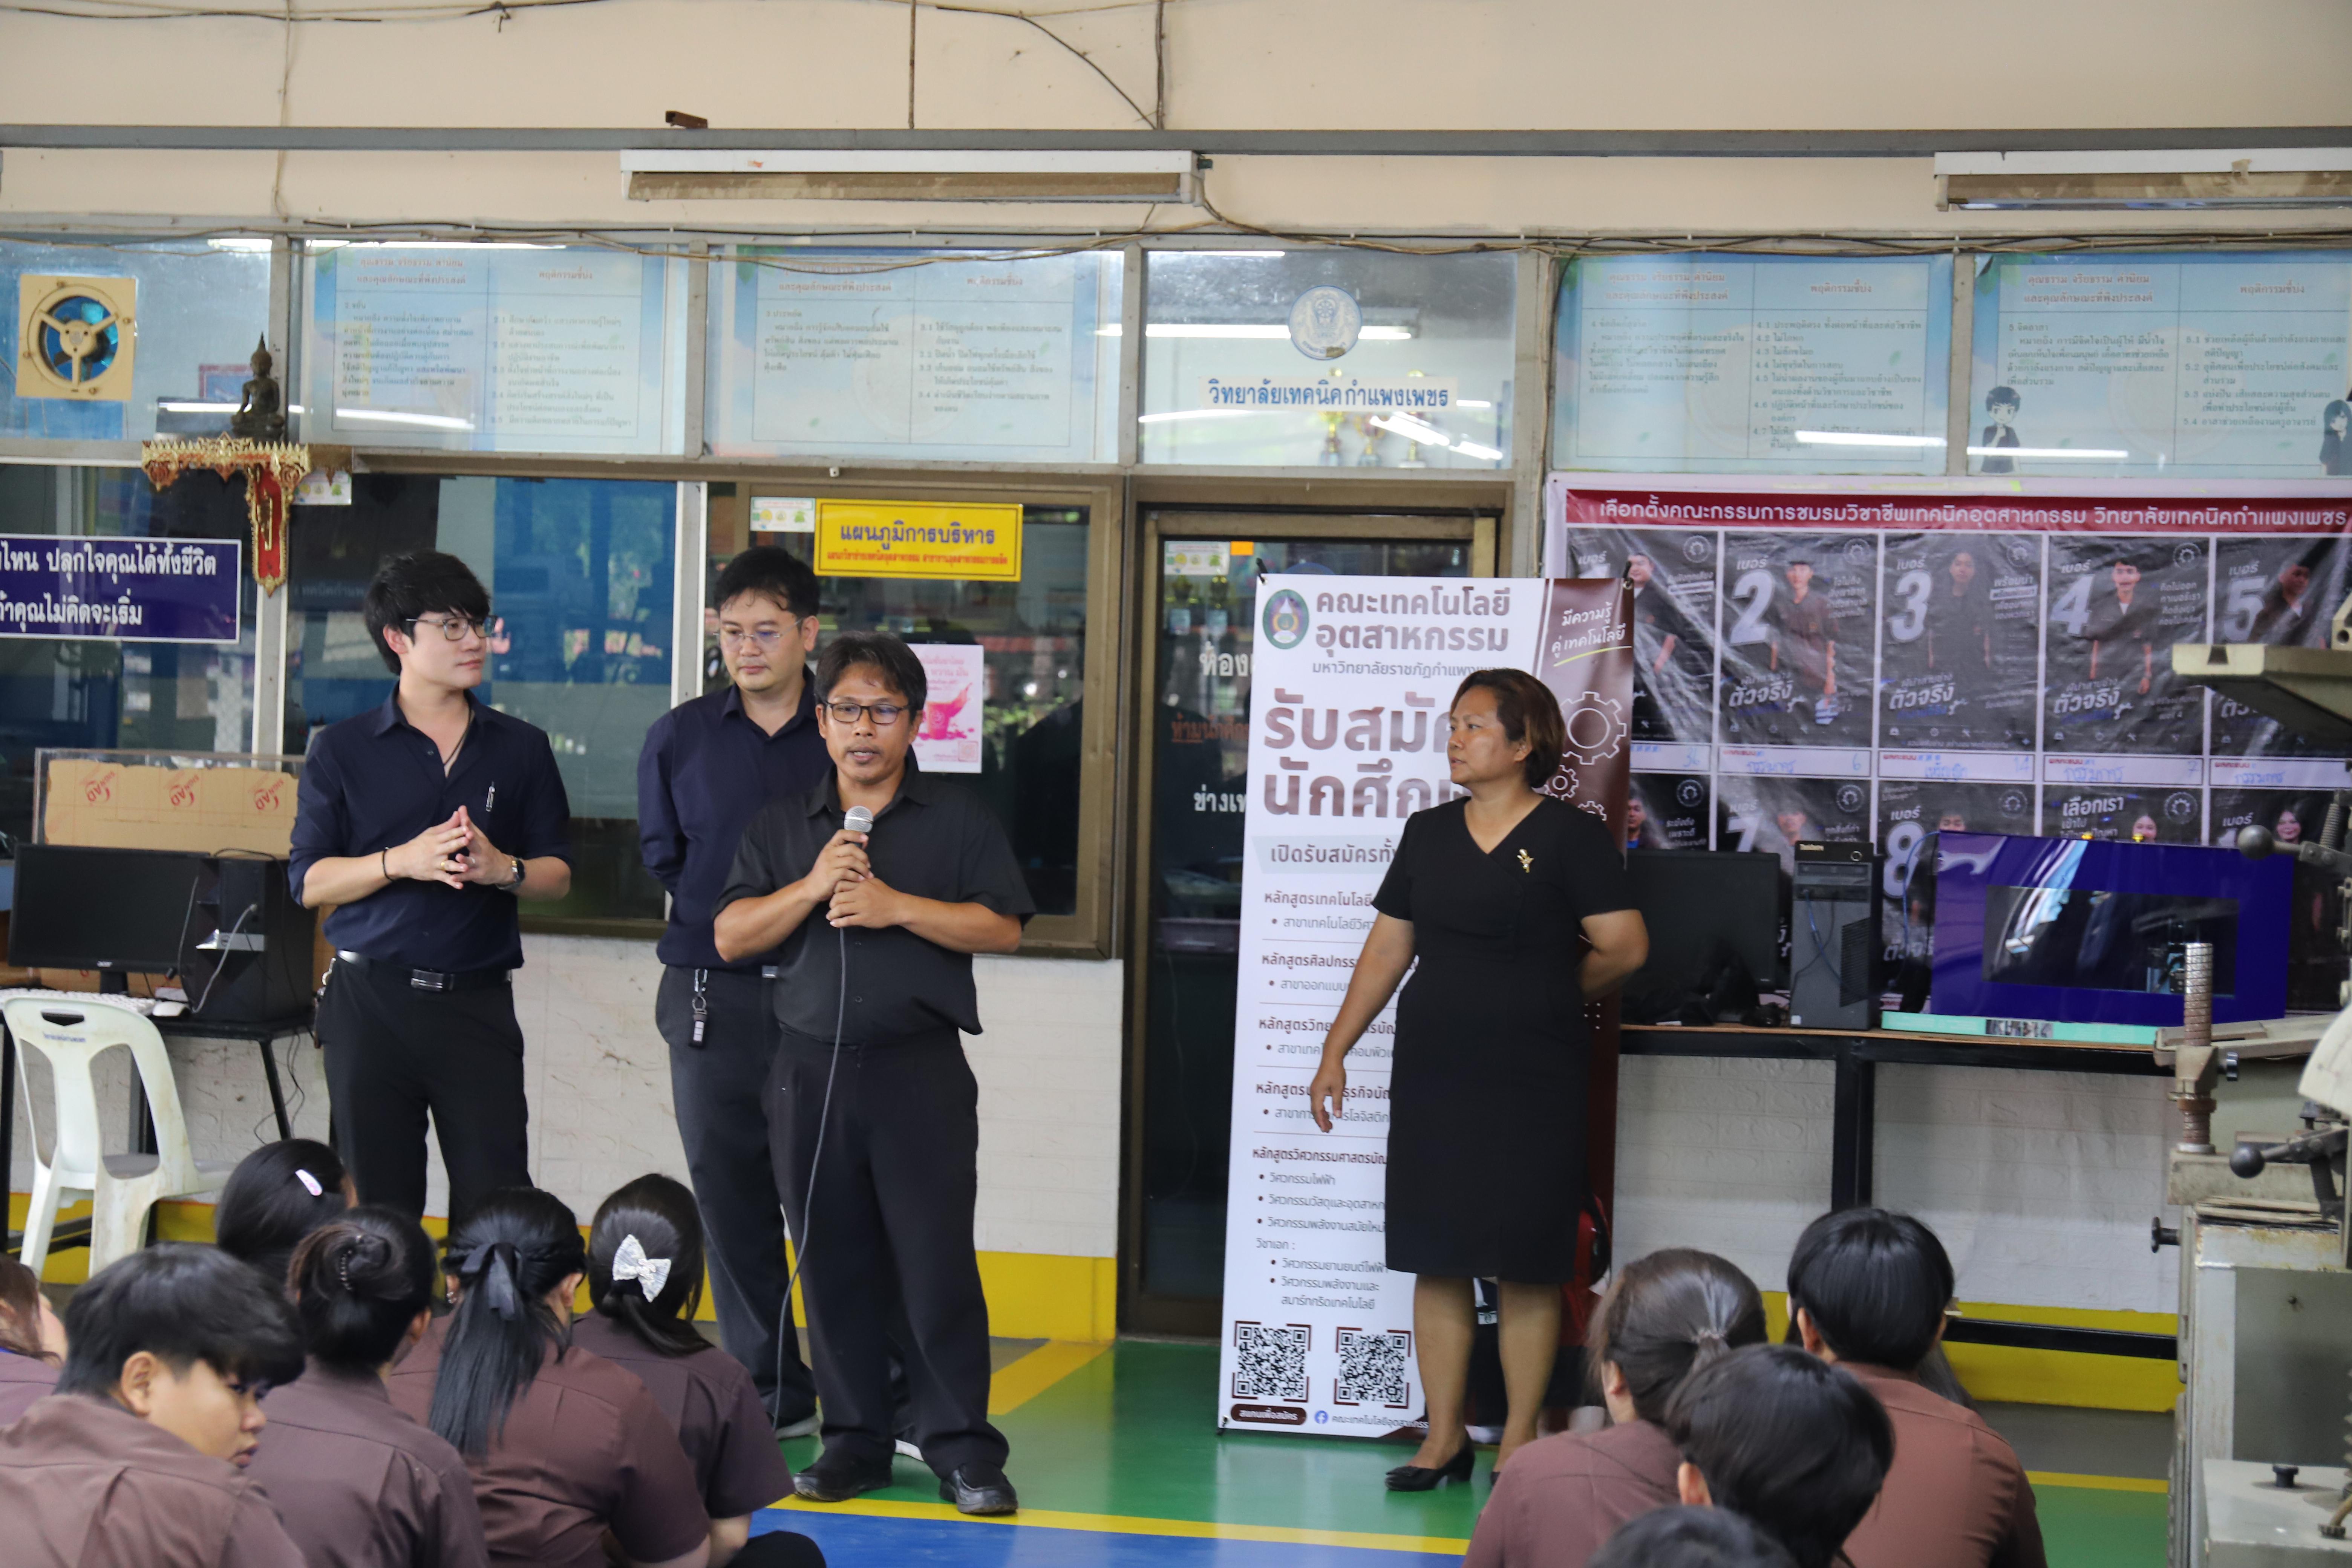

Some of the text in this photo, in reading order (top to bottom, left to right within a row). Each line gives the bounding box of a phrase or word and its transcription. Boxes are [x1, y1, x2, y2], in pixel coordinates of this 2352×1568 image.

[1209, 378, 1448, 407] วิทยาลัยเทคนิคกำแพงเพชร
[1600, 495, 2346, 528] เลือกตั้งคณะกรรมการชมรมวิชาชีพเทคนิคอุตสาหกรรม วิทยาลัยเทคนิคกำแพงเพชร
[841, 519, 995, 549] แผนภูมิการบริหาร
[46, 541, 216, 584] ปลุกใจคุณได้ทั้งชีวิต
[2061, 559, 2091, 574] เบอร์
[2228, 560, 2260, 576] เบอร์
[1316, 586, 1511, 616] คณะเทคโนโลยี
[1562, 601, 1612, 629] มีความรู้
[1730, 569, 1773, 645] 2
[1889, 569, 1932, 642] 3
[2050, 573, 2095, 637] 4
[2223, 575, 2268, 643] 5
[1315, 623, 1508, 657] อุตสาหกรรม
[1551, 623, 1626, 659] คู่ เทคโนโลยี
[1199, 641, 1253, 677] ห้อง
[1312, 660, 1507, 679] มหาวิทยาลัยราชภัฏกำแพง
[1729, 681, 1794, 707] ตัวจริง
[1888, 681, 1955, 710] ตัวจริง
[2053, 686, 2121, 714] ตัวจริง
[1890, 805, 1921, 821] เบอร์
[2063, 796, 2124, 817] เลือกเรา
[2222, 813, 2253, 827] เบอร์
[1883, 820, 1925, 899] 8
[1262, 952, 1359, 970] หลักสูตรศิลปกรร
[1280, 980, 1349, 992] สาขาออกแบบ
